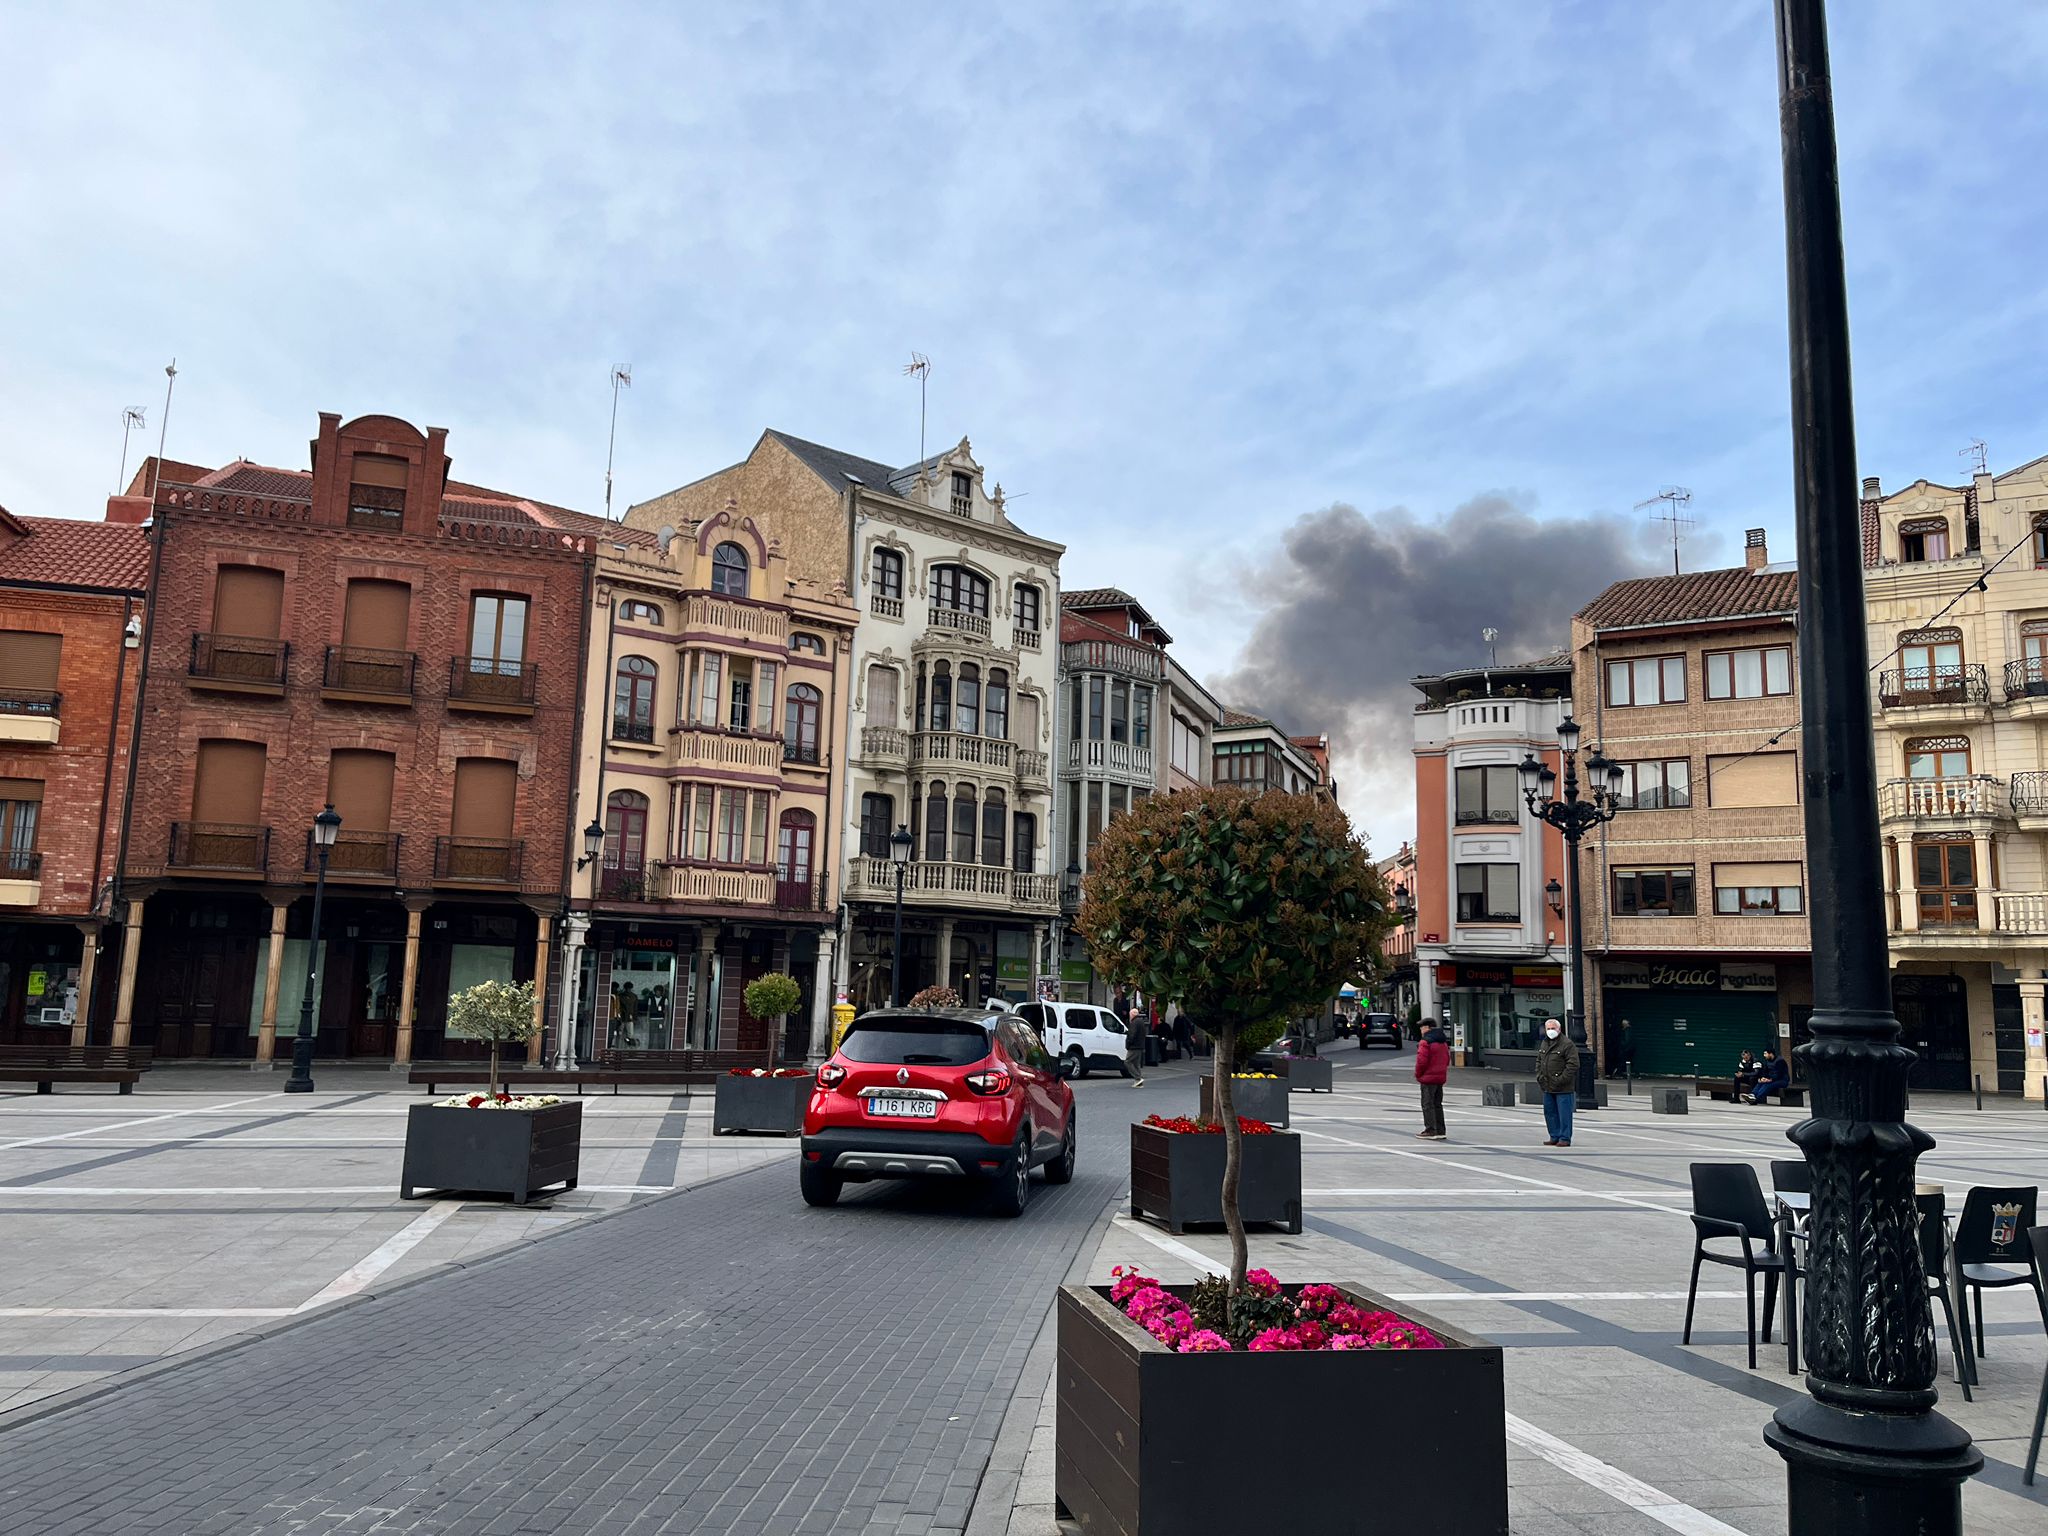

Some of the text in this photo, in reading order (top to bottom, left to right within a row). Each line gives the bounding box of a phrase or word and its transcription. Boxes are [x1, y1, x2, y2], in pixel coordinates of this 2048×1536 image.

[1720, 973, 1775, 988] regalos
[879, 1100, 932, 1113] 1161 KRG
